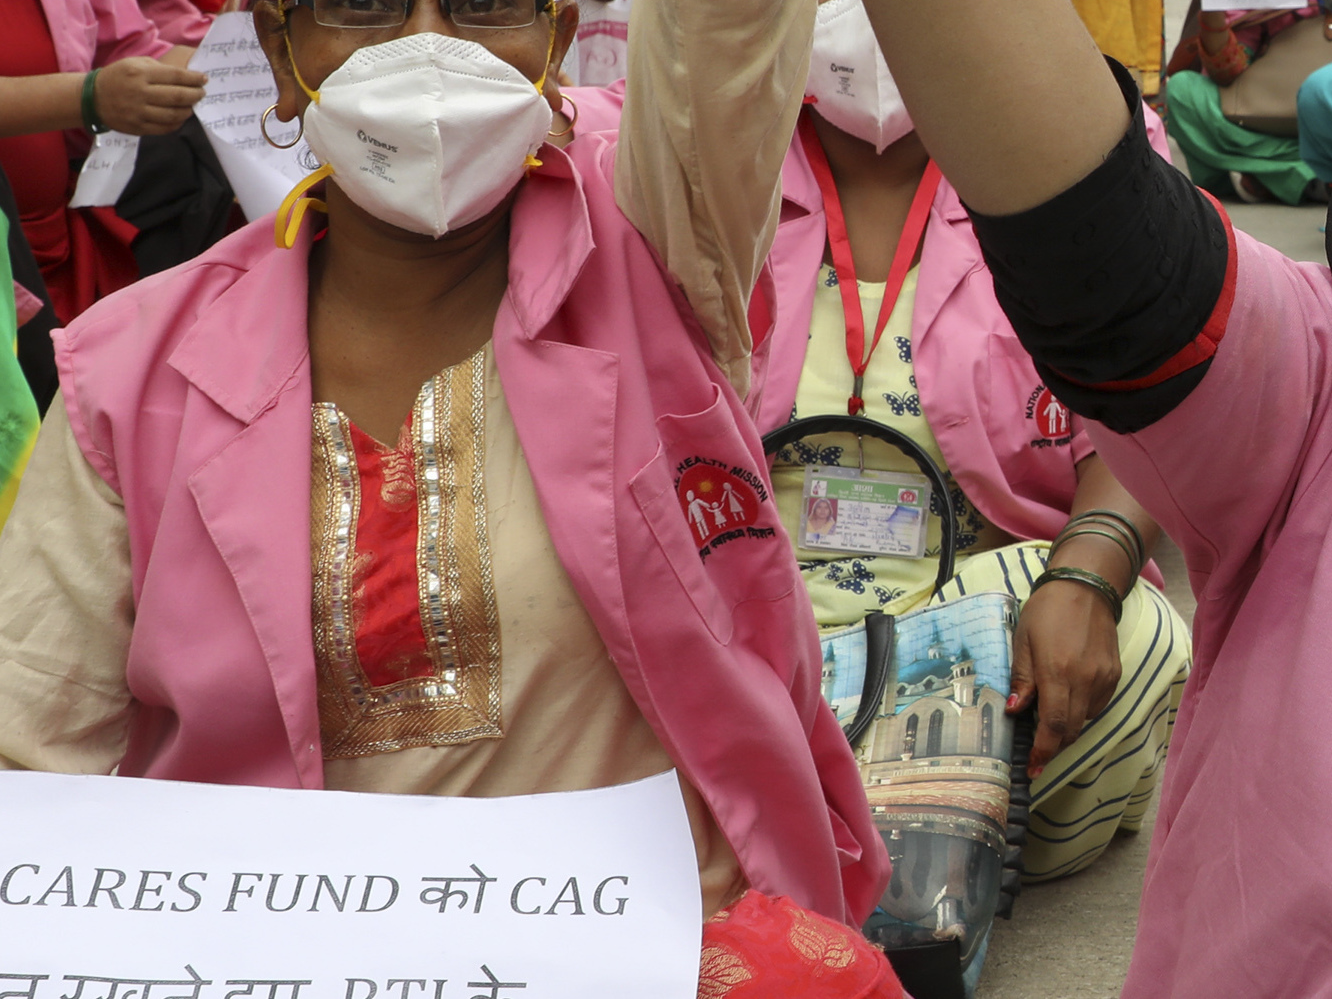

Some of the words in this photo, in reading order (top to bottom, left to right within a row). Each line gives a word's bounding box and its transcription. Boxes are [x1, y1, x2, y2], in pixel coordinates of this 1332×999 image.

[677, 456, 727, 475] HEALTH
[730, 466, 768, 503] MISSION
[0, 863, 207, 913] CARES
[222, 872, 401, 914] FUND
[420, 863, 497, 915] को
[509, 874, 629, 916] CAG
